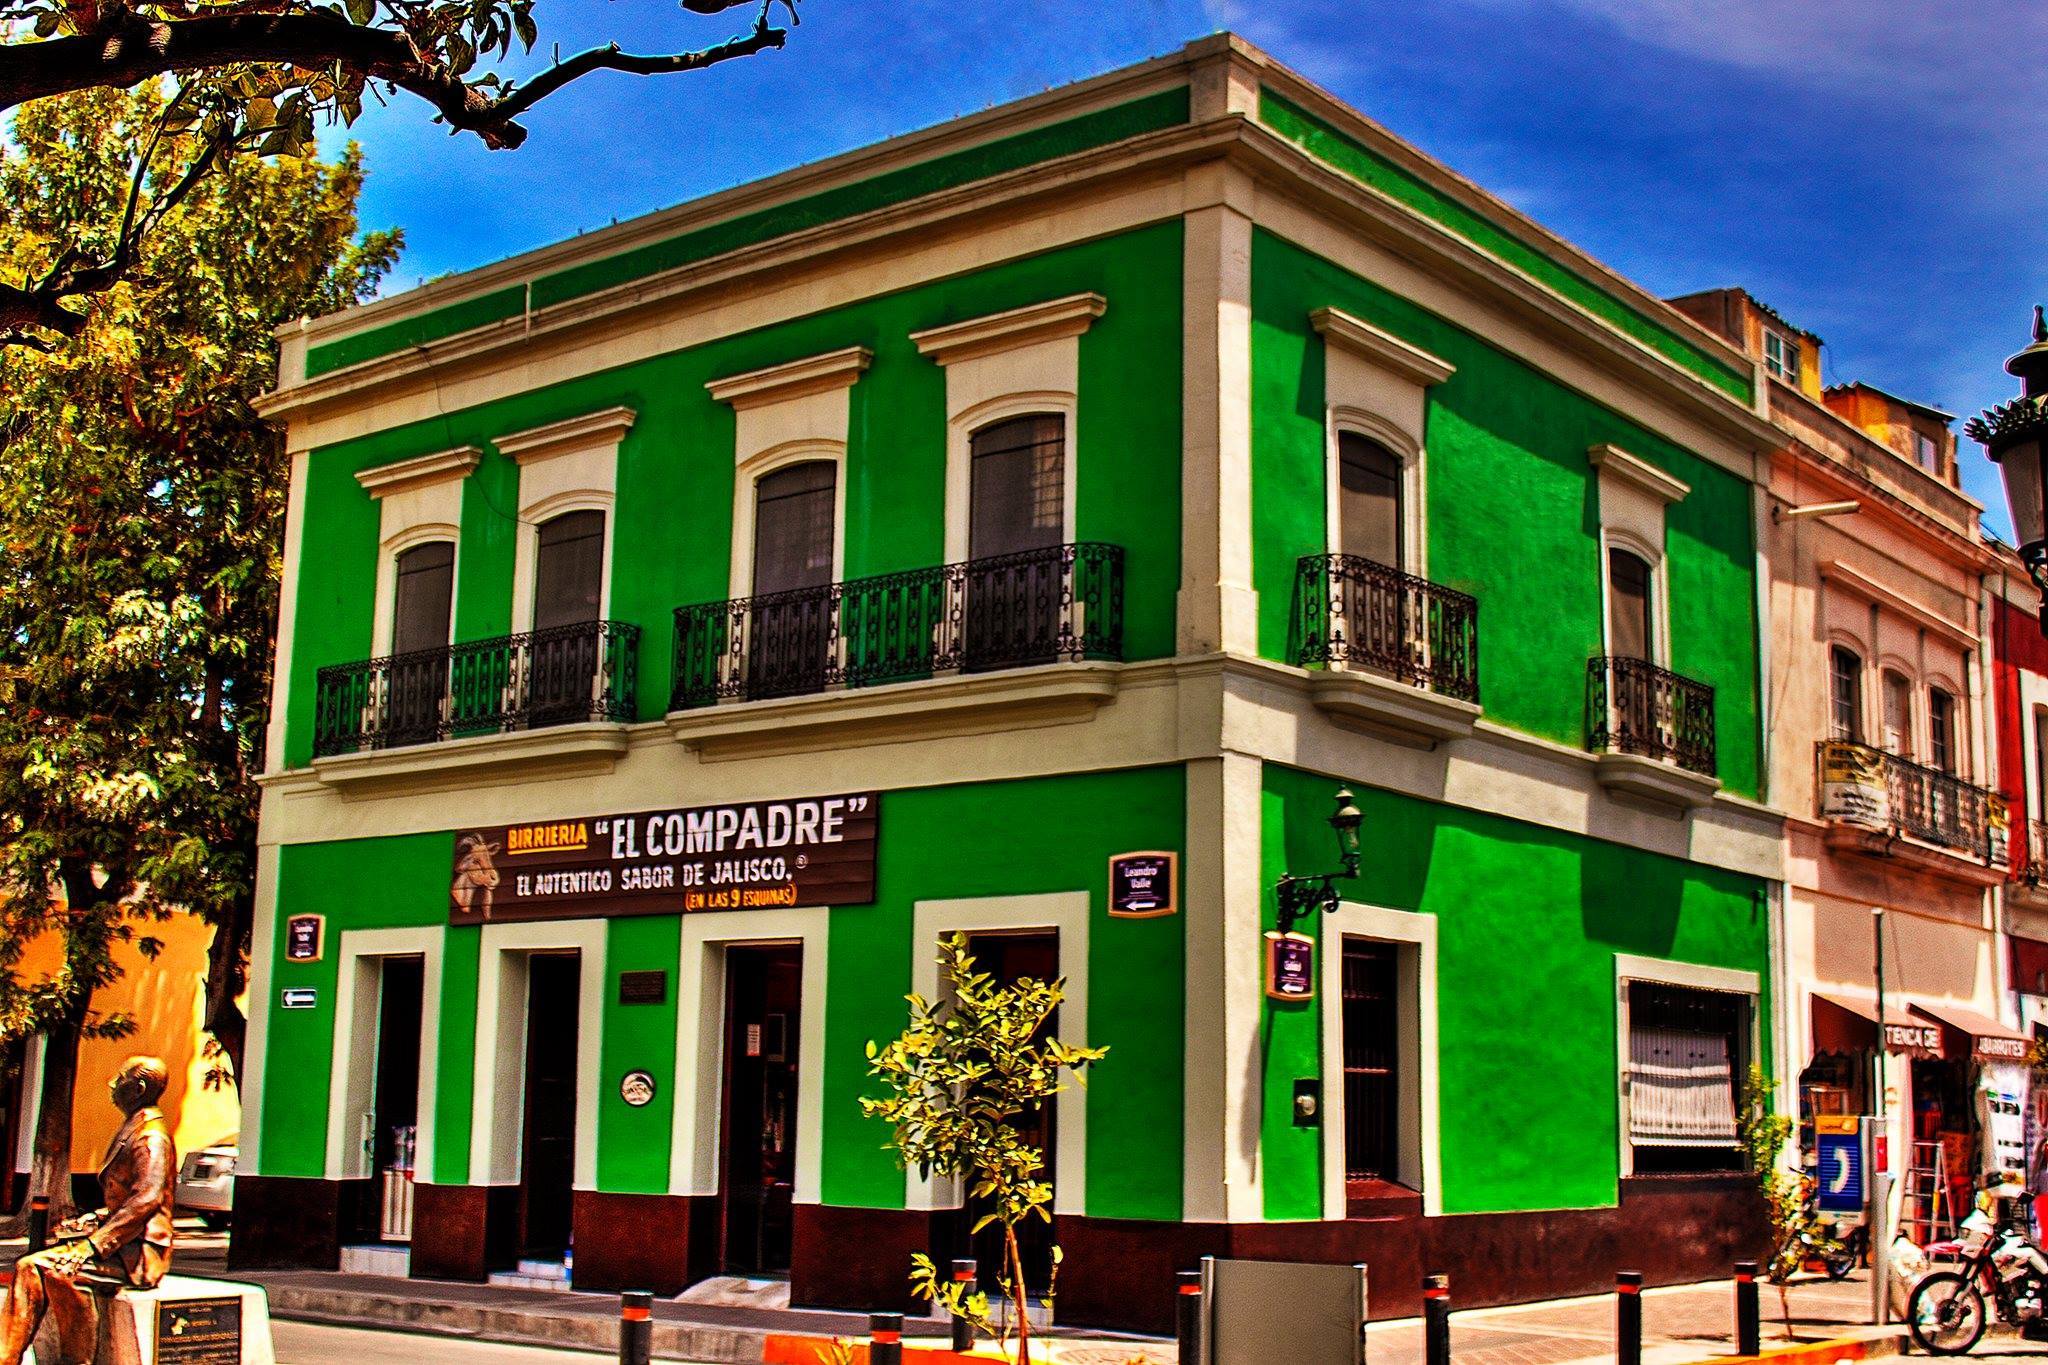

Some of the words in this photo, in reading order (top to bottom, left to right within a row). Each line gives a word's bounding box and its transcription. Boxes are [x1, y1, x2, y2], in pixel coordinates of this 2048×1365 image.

[507, 822, 588, 850] BIRRIERIA
[516, 874, 532, 896] EL
[621, 864, 674, 890] SABOR
[683, 862, 704, 887] DE
[1124, 866, 1158, 877] Leandro
[708, 892, 728, 908] LAS
[730, 888, 741, 908] 9
